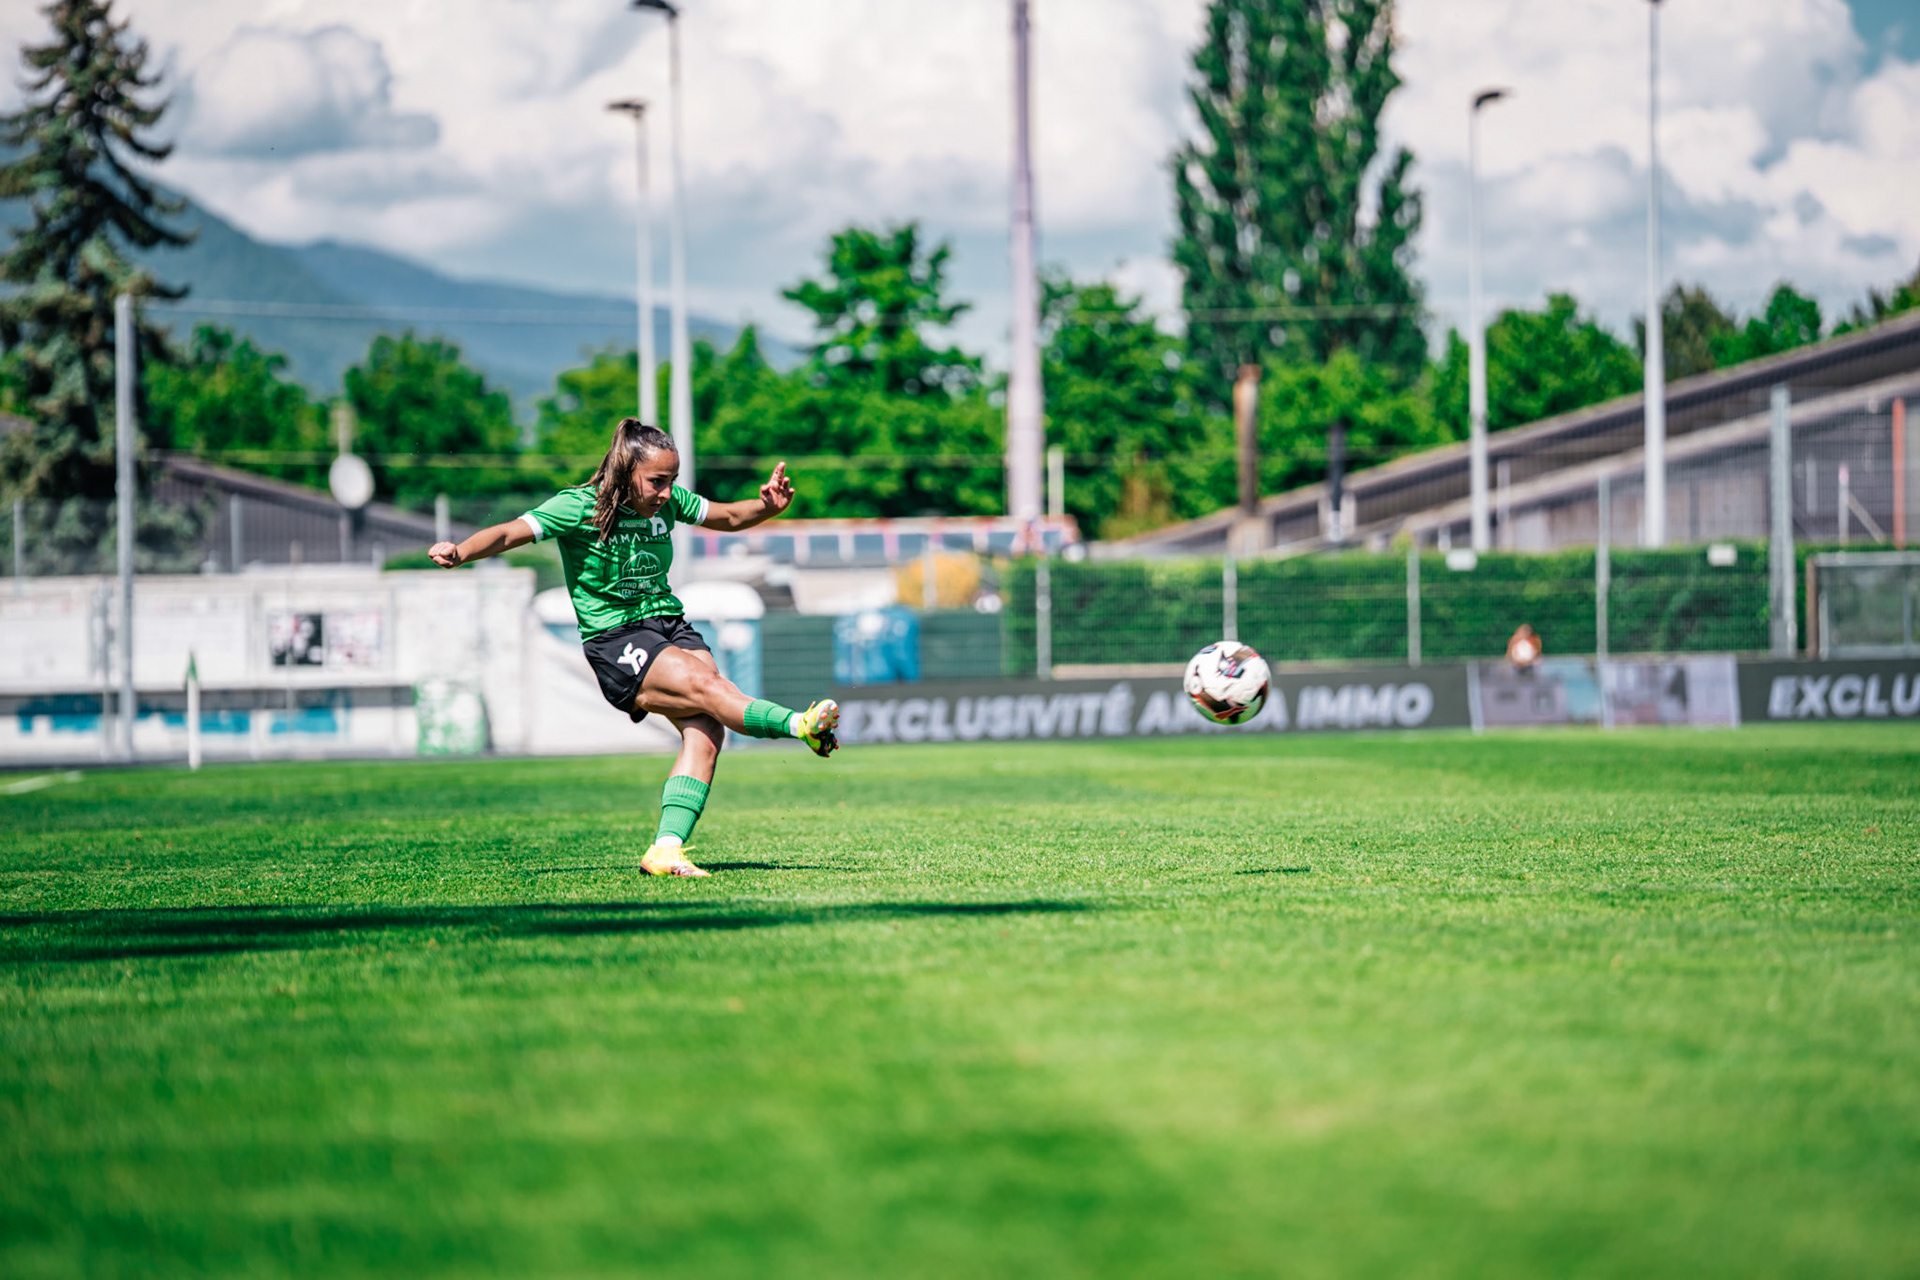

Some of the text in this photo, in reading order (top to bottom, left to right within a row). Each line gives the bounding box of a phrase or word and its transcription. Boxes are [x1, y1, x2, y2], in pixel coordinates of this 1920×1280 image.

[838, 681, 1134, 743] EXCLUSIVITÉ
[1296, 681, 1434, 731] IMMO
[1767, 672, 1920, 719] EXCLU
